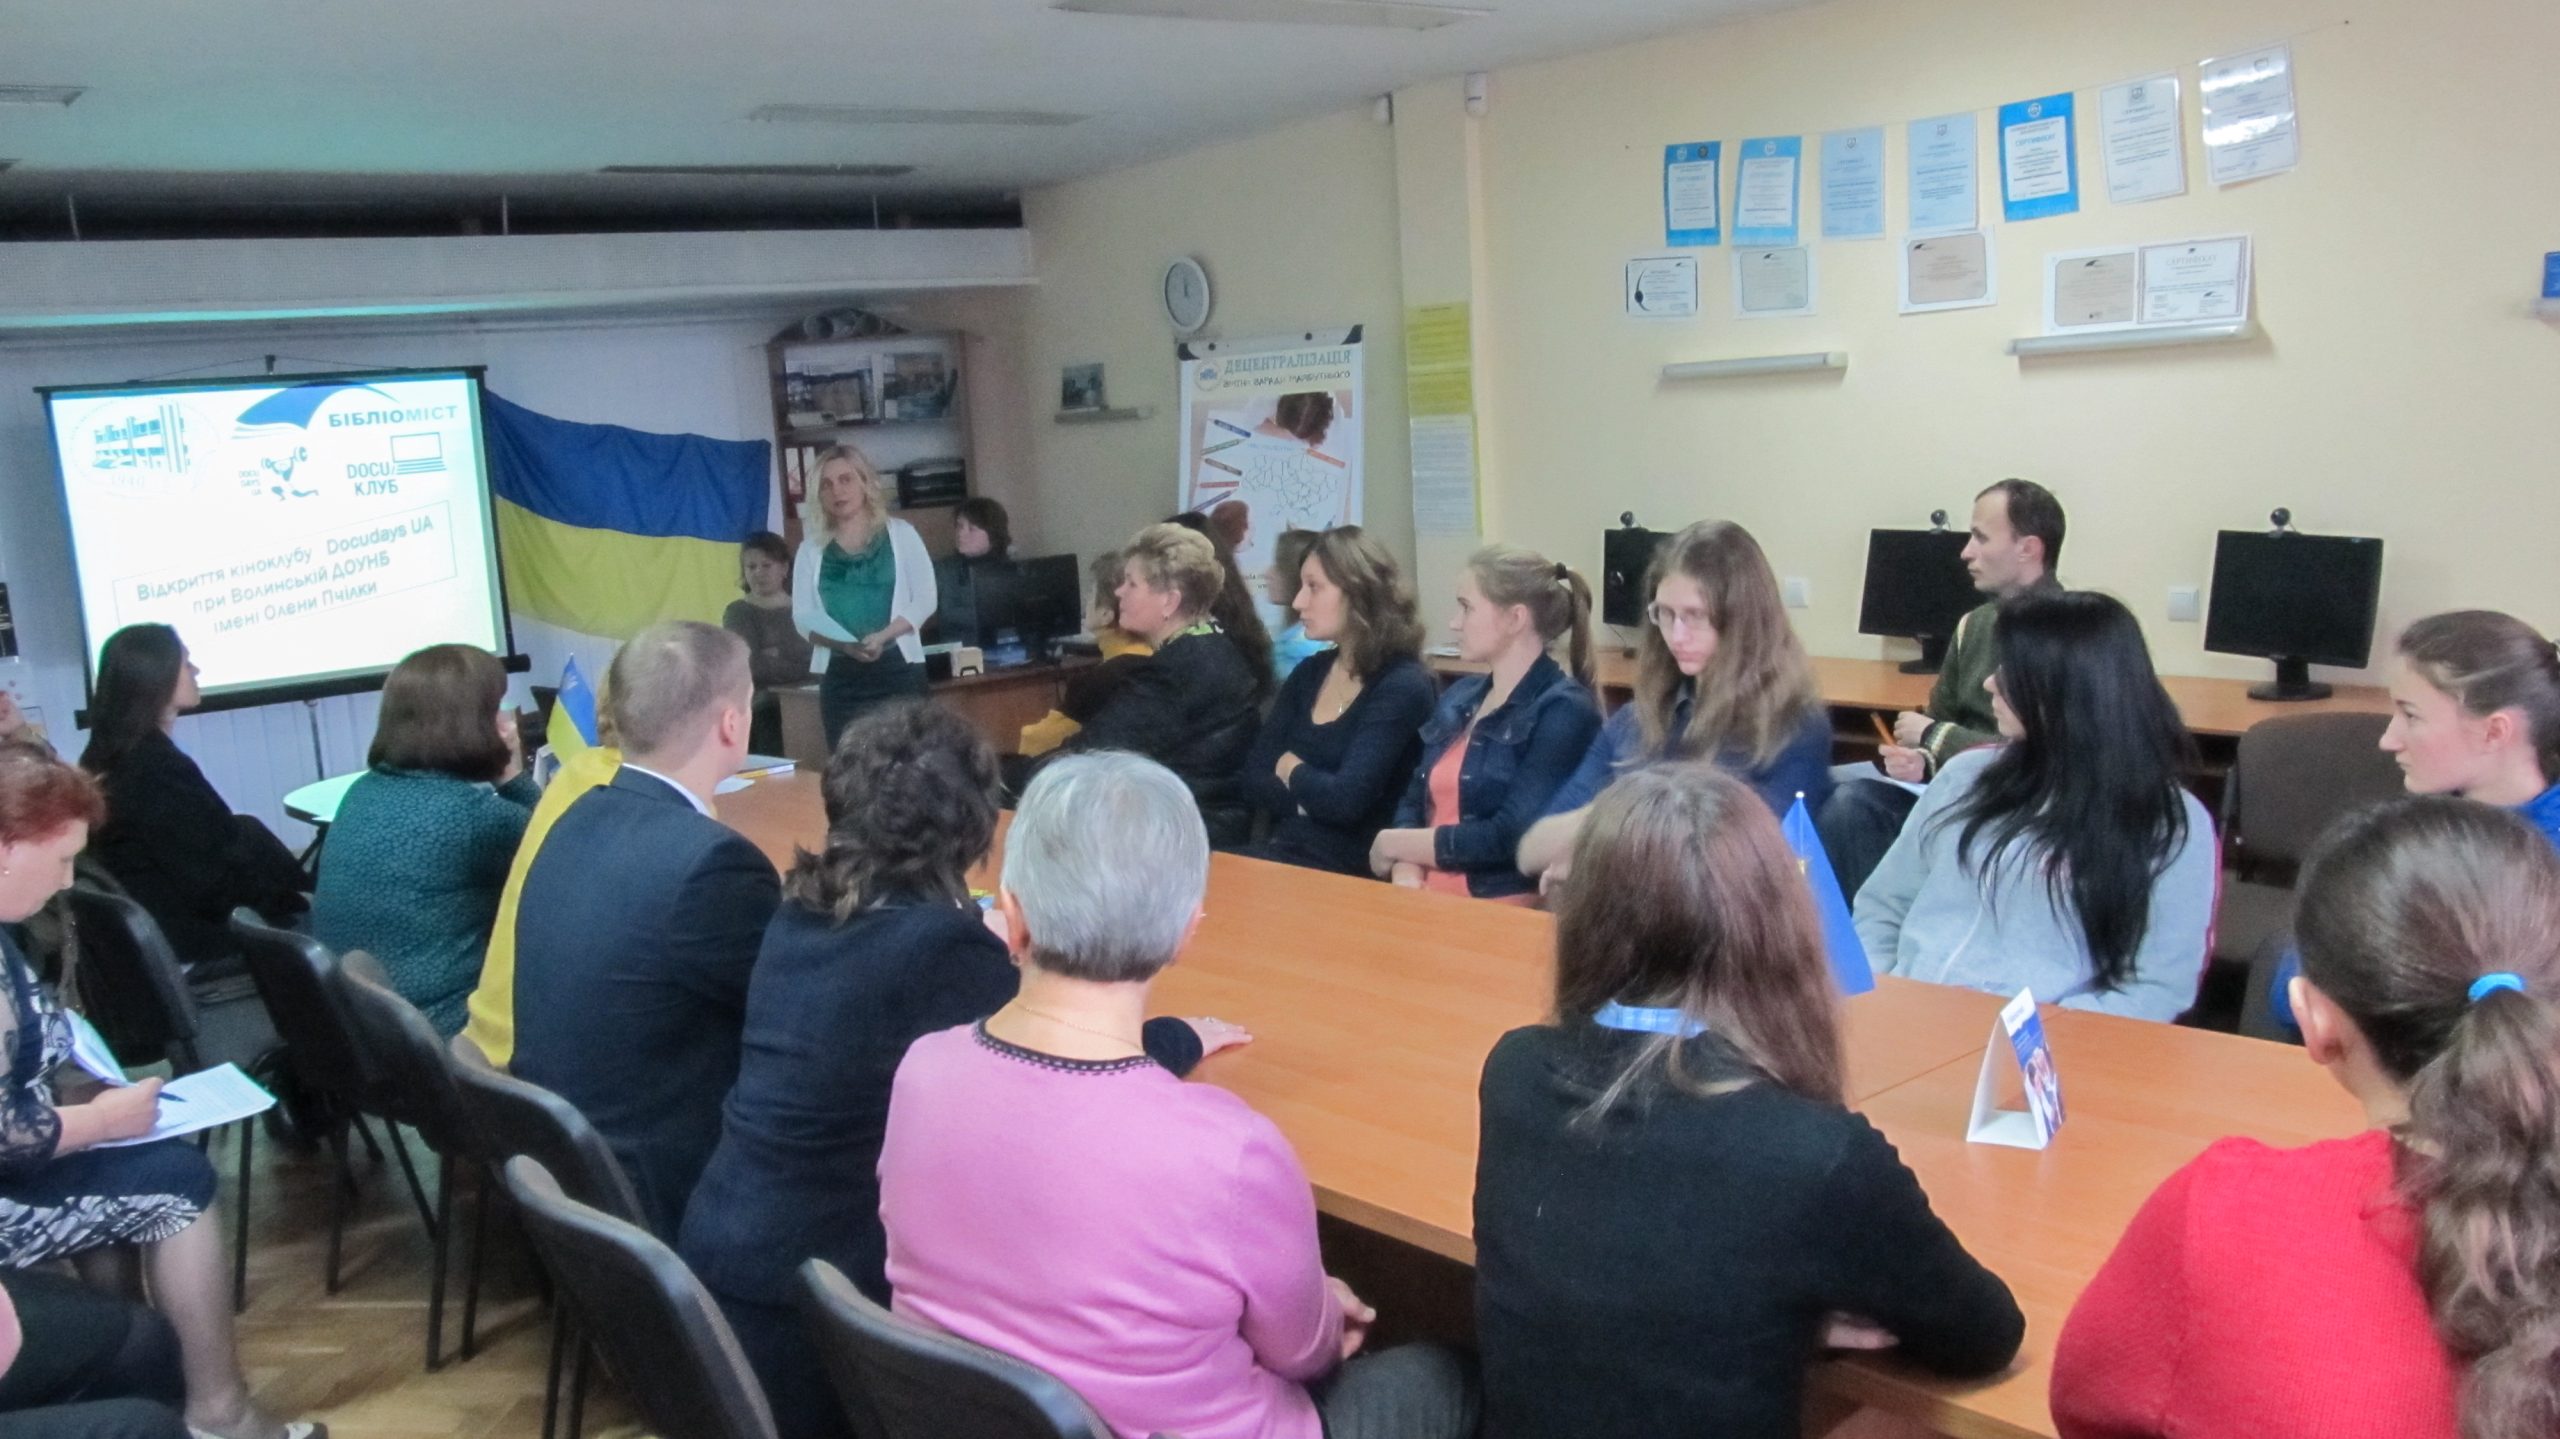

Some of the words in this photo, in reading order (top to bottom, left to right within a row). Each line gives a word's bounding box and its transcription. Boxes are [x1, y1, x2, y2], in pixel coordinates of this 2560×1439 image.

[1224, 349, 1352, 375] ДЕЦЕНТРАЛІЗАЦІЯ
[328, 404, 458, 428] БІБЛІОМІСТ
[355, 479, 399, 497] КЛУБ
[136, 568, 225, 601] Відкриття
[230, 547, 313, 578] кіноклубу
[326, 524, 407, 556] Docudays
[410, 515, 434, 534] UA
[192, 596, 226, 614] при
[231, 566, 328, 604] Волинській
[332, 550, 391, 582] ДОУНБ
[213, 612, 260, 634] імені
[264, 596, 318, 621] Олени
[322, 580, 378, 606] Пчілки
